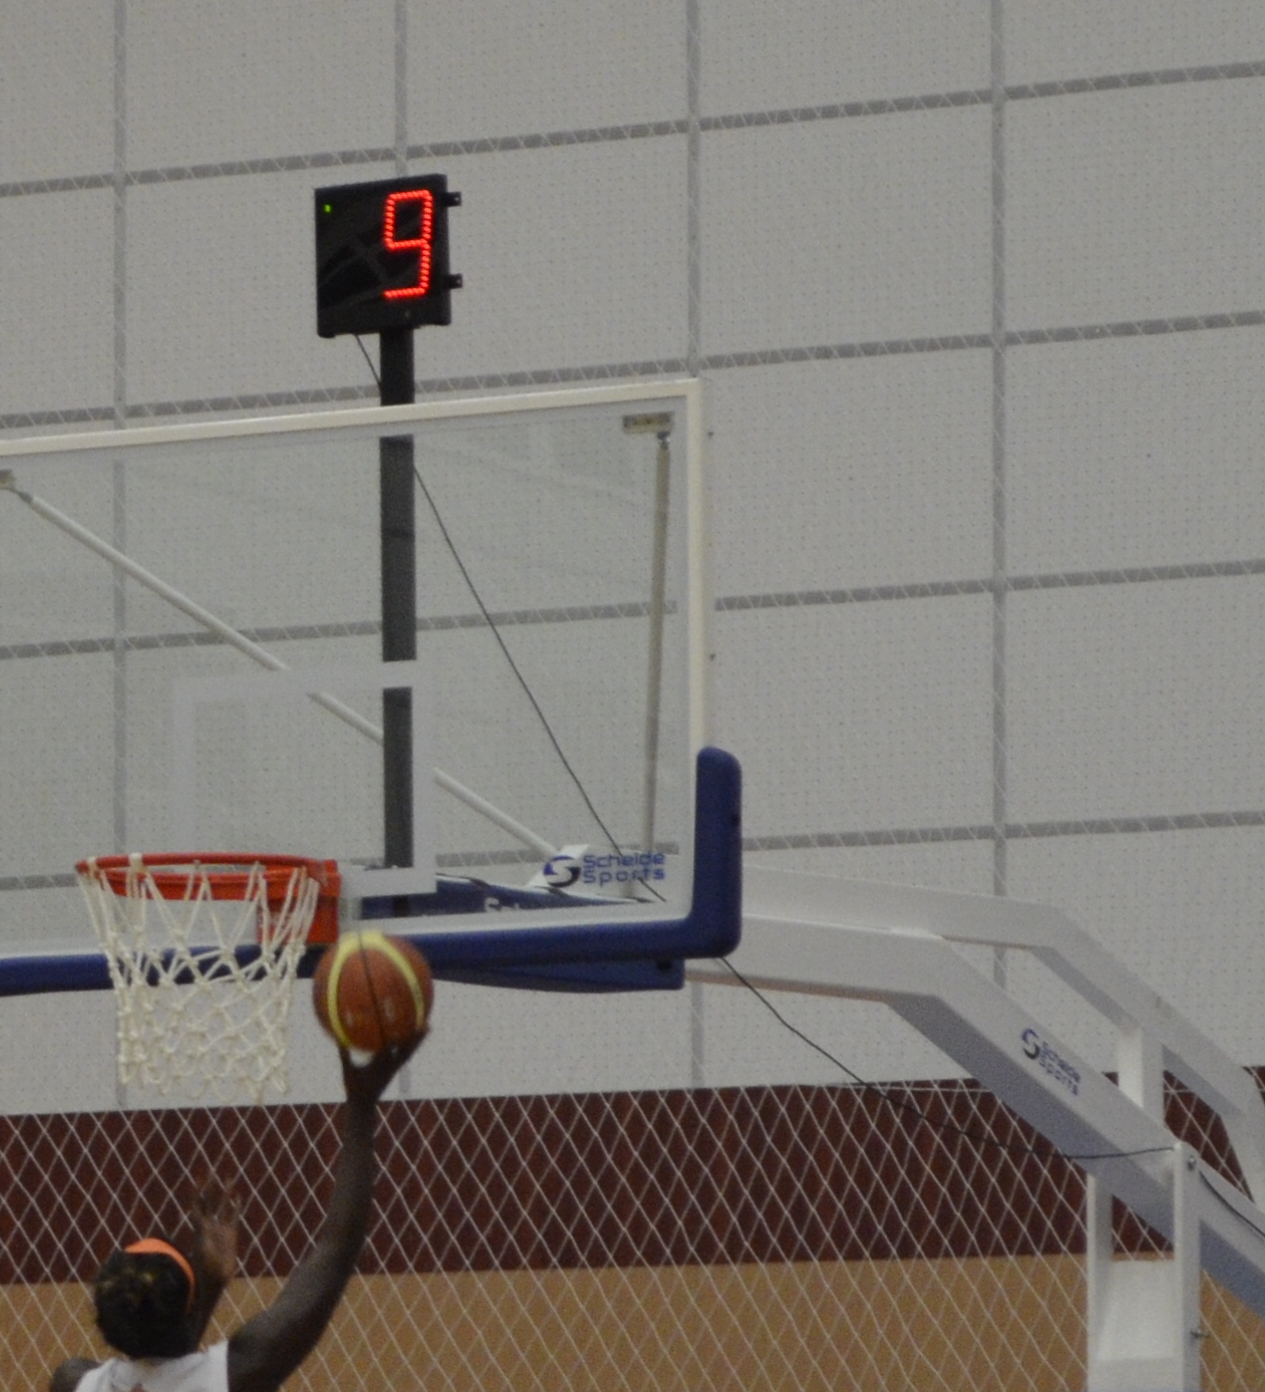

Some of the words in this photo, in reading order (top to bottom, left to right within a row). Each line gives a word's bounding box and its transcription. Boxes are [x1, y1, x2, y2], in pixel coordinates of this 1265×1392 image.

[384, 188, 434, 300] 9
[583, 852, 666, 868] Schelde
[583, 868, 666, 888] Sports
